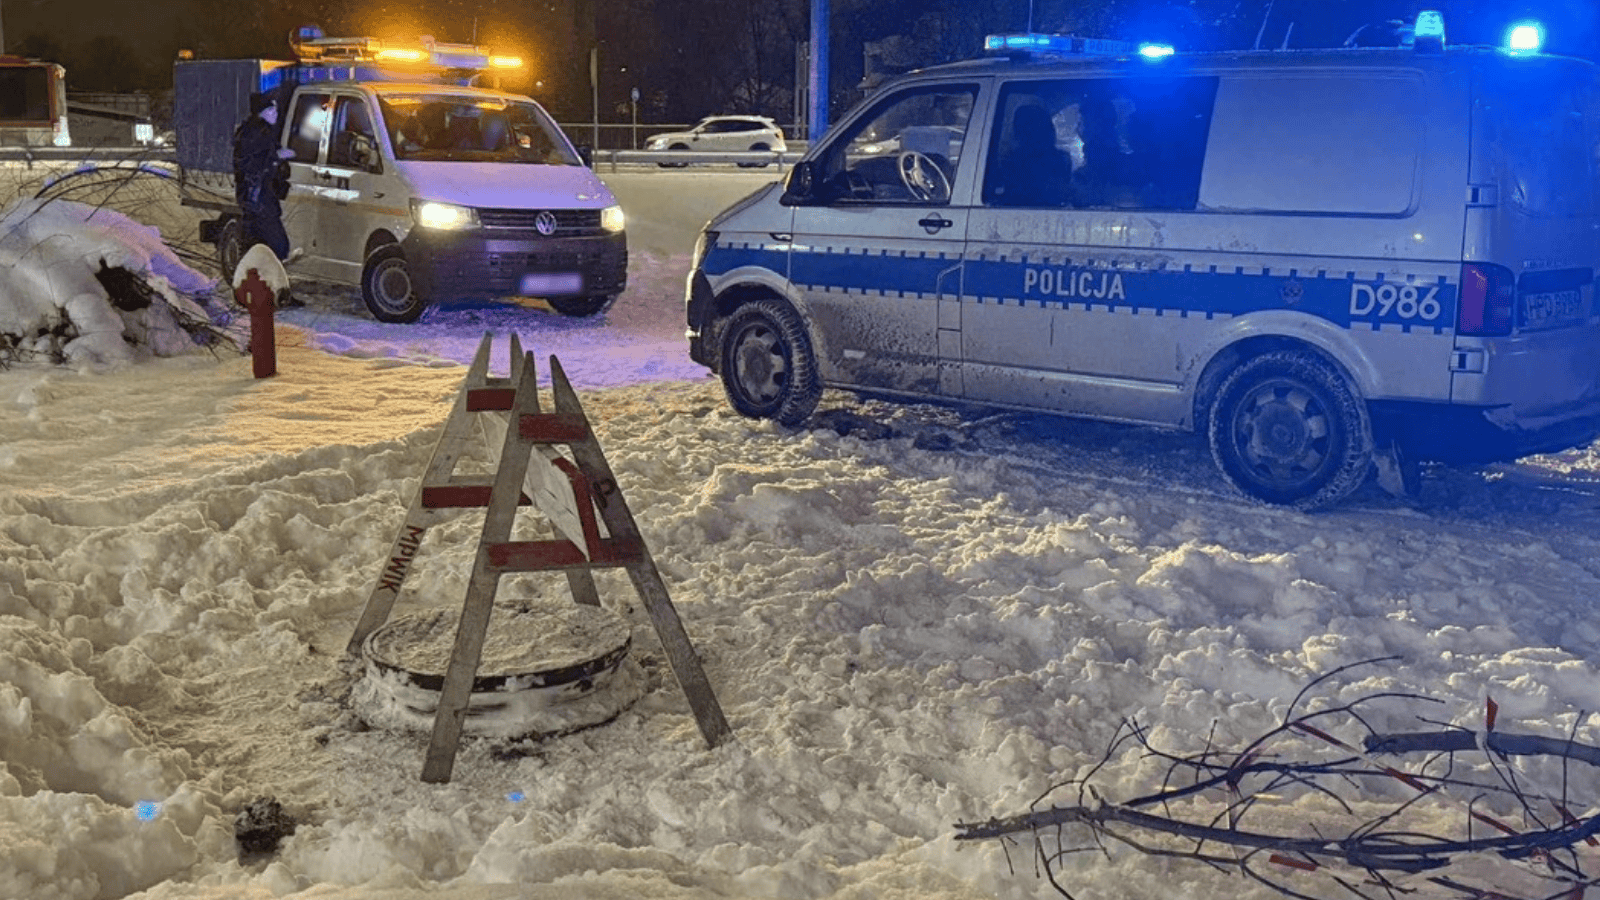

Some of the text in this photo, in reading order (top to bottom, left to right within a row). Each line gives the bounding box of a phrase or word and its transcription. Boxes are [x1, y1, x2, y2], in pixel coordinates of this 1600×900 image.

[1023, 268, 1125, 299] POLICJA
[1349, 283, 1441, 320] D986
[378, 525, 424, 593] MPWIK
